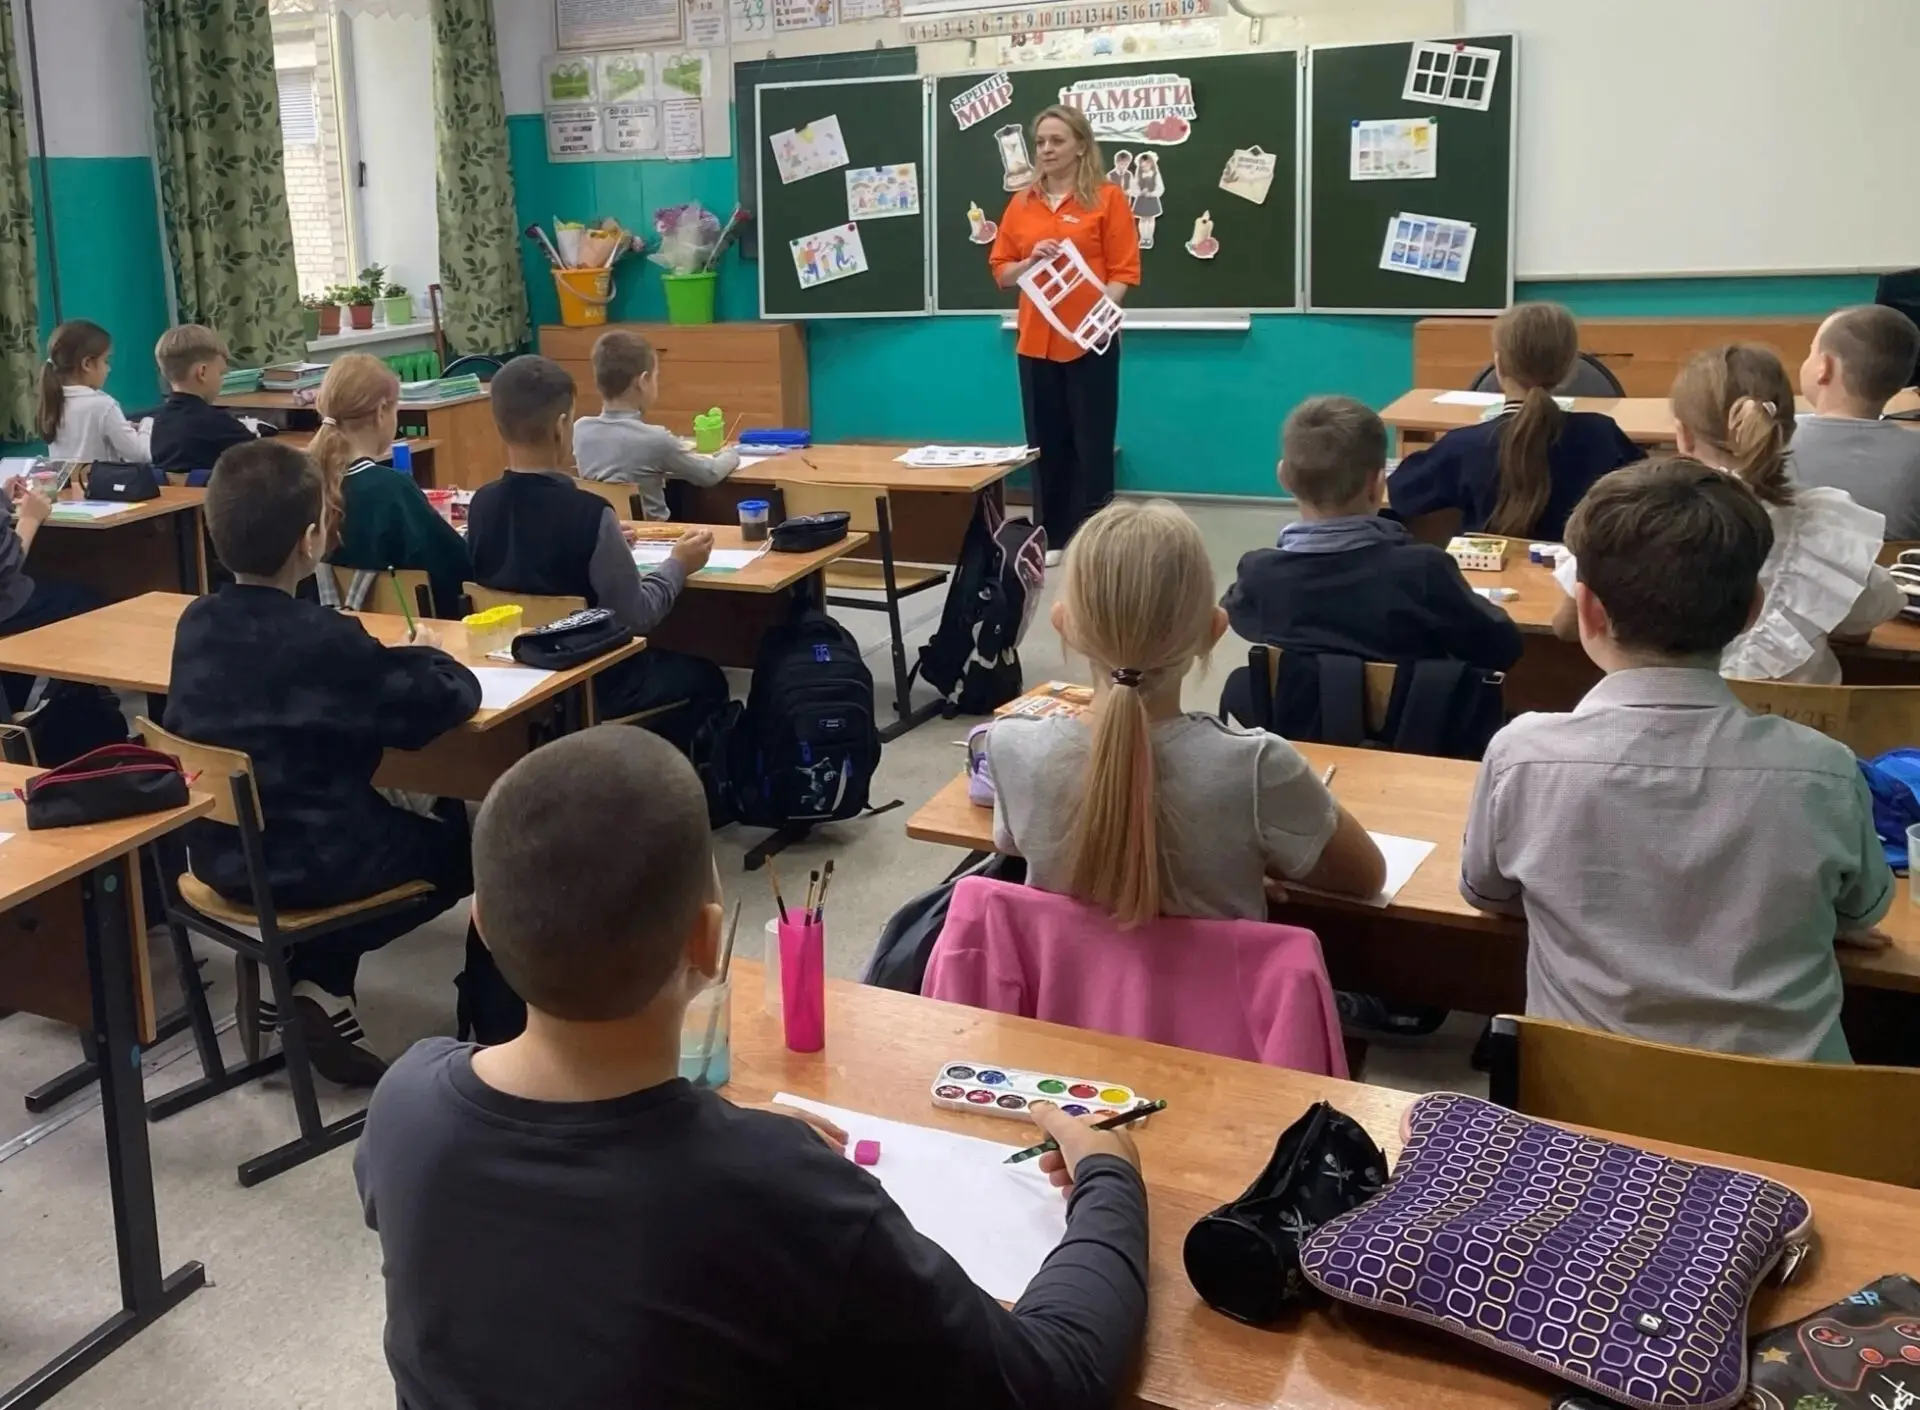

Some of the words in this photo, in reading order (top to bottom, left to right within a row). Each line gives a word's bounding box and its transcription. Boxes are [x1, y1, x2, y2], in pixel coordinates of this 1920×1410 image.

[982, 18, 989, 32] 6
[996, 17, 1004, 30] 7
[1011, 15, 1018, 28] 8
[1026, 14, 1033, 27] 9
[1039, 12, 1051, 26] 10
[1056, 11, 1066, 25] 11
[1070, 10, 1081, 24] 12
[1085, 9, 1097, 23] 13
[1100, 7, 1112, 21] 14
[1116, 6, 1128, 20] 15
[1132, 5, 1145, 19] 16
[1149, 3, 1161, 17] 17
[1165, 1, 1177, 15] 18
[1181, 0, 1194, 14] 19
[1198, 0, 1209, 13] 20
[952, 72, 1008, 111] БЕРЕГИТЕ
[1077, 77, 1154, 90] МЕЖДУНАРОДНЫЙ
[957, 84, 1013, 127] МИР
[1063, 85, 1192, 112] ПАМЯТИ
[1084, 111, 1115, 125] РТВ
[1119, 106, 1195, 122] ФАШИЗМА
[1848, 1291, 1880, 1306] ER
